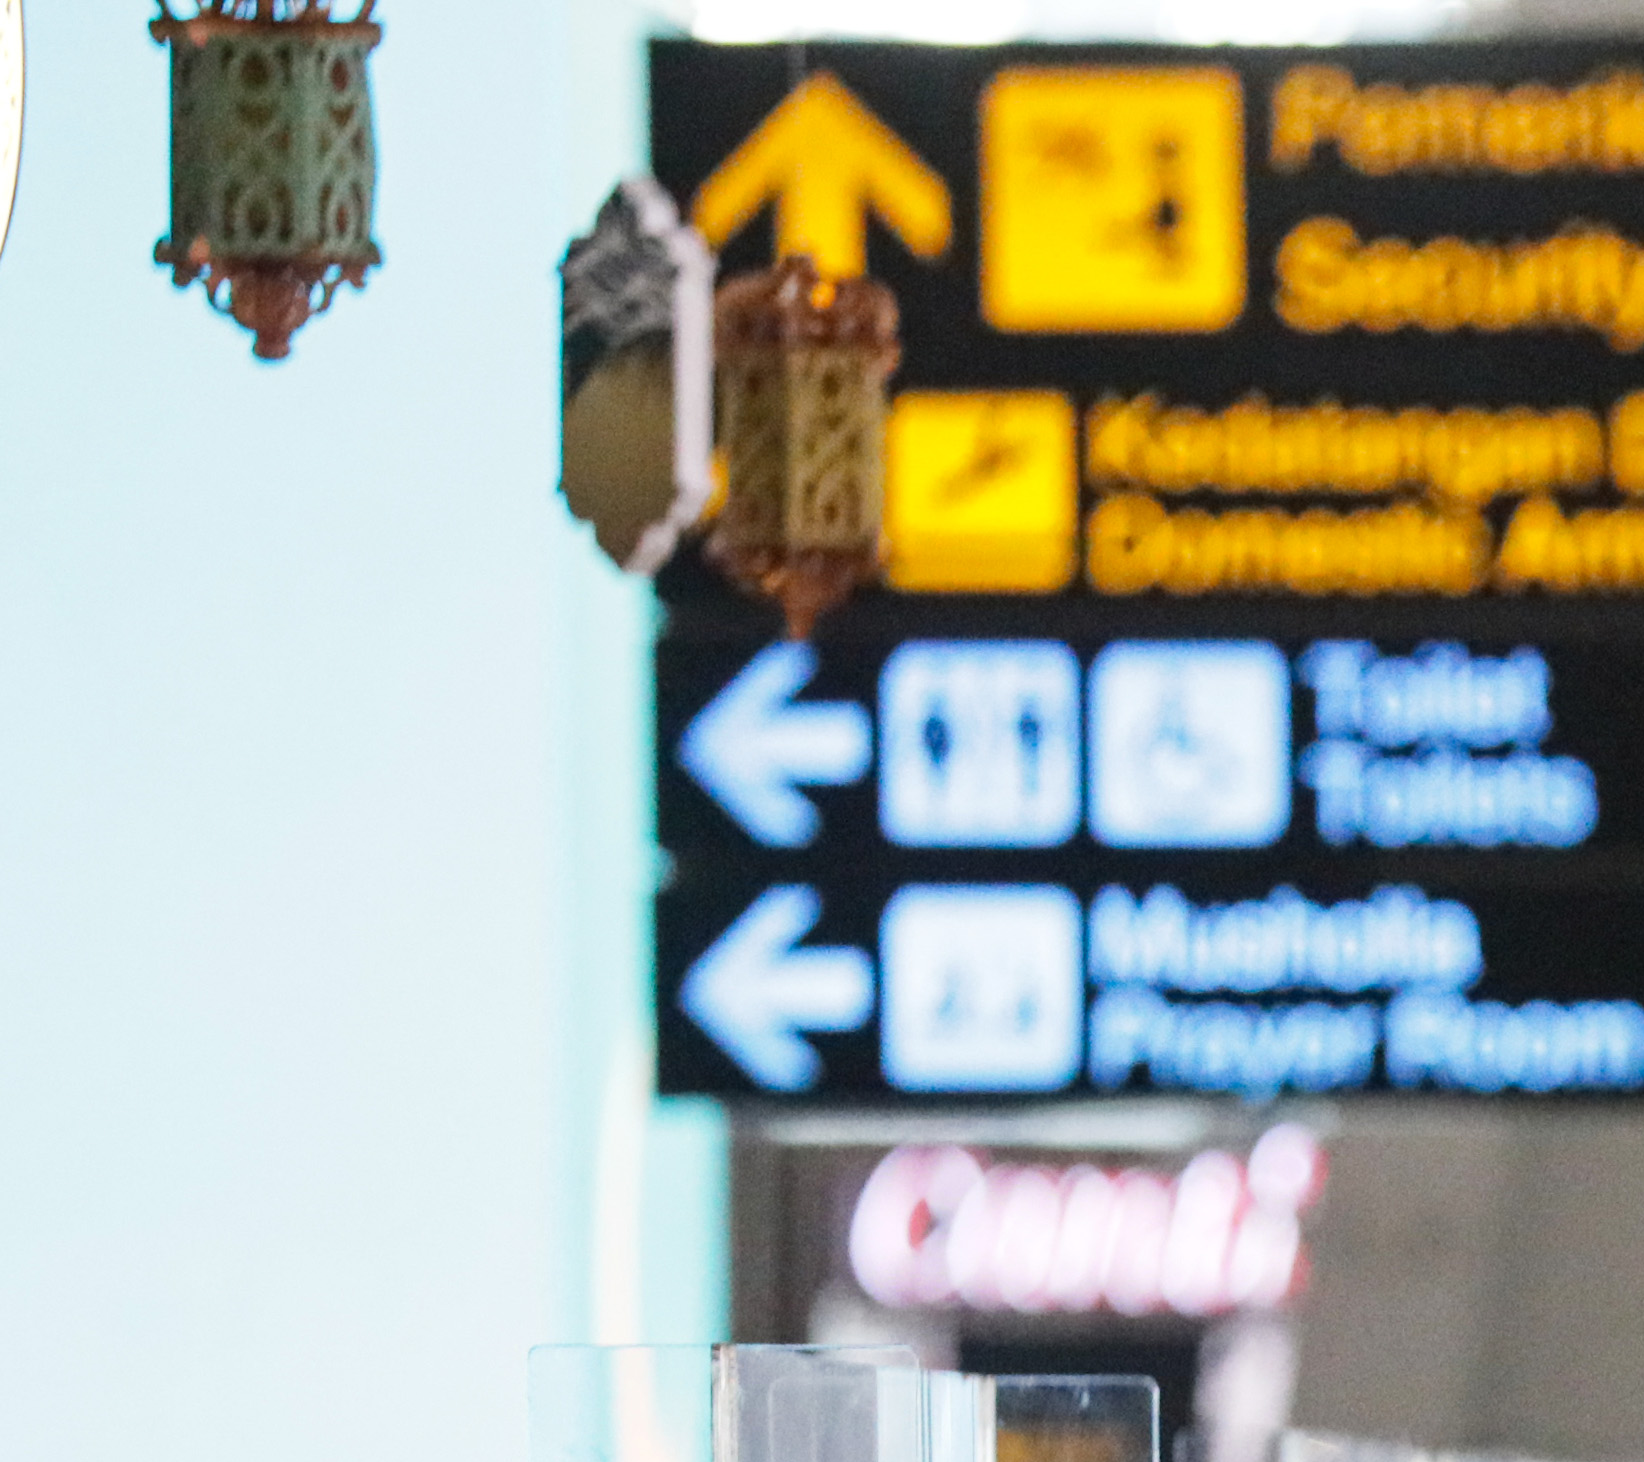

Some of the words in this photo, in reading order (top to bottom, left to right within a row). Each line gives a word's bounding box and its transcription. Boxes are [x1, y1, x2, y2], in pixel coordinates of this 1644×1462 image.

[1088, 492, 1490, 597] Domestic
[1301, 638, 1553, 748] Toilet
[1301, 740, 1597, 849] Toilets
[1089, 985, 1379, 1100] Prayer
